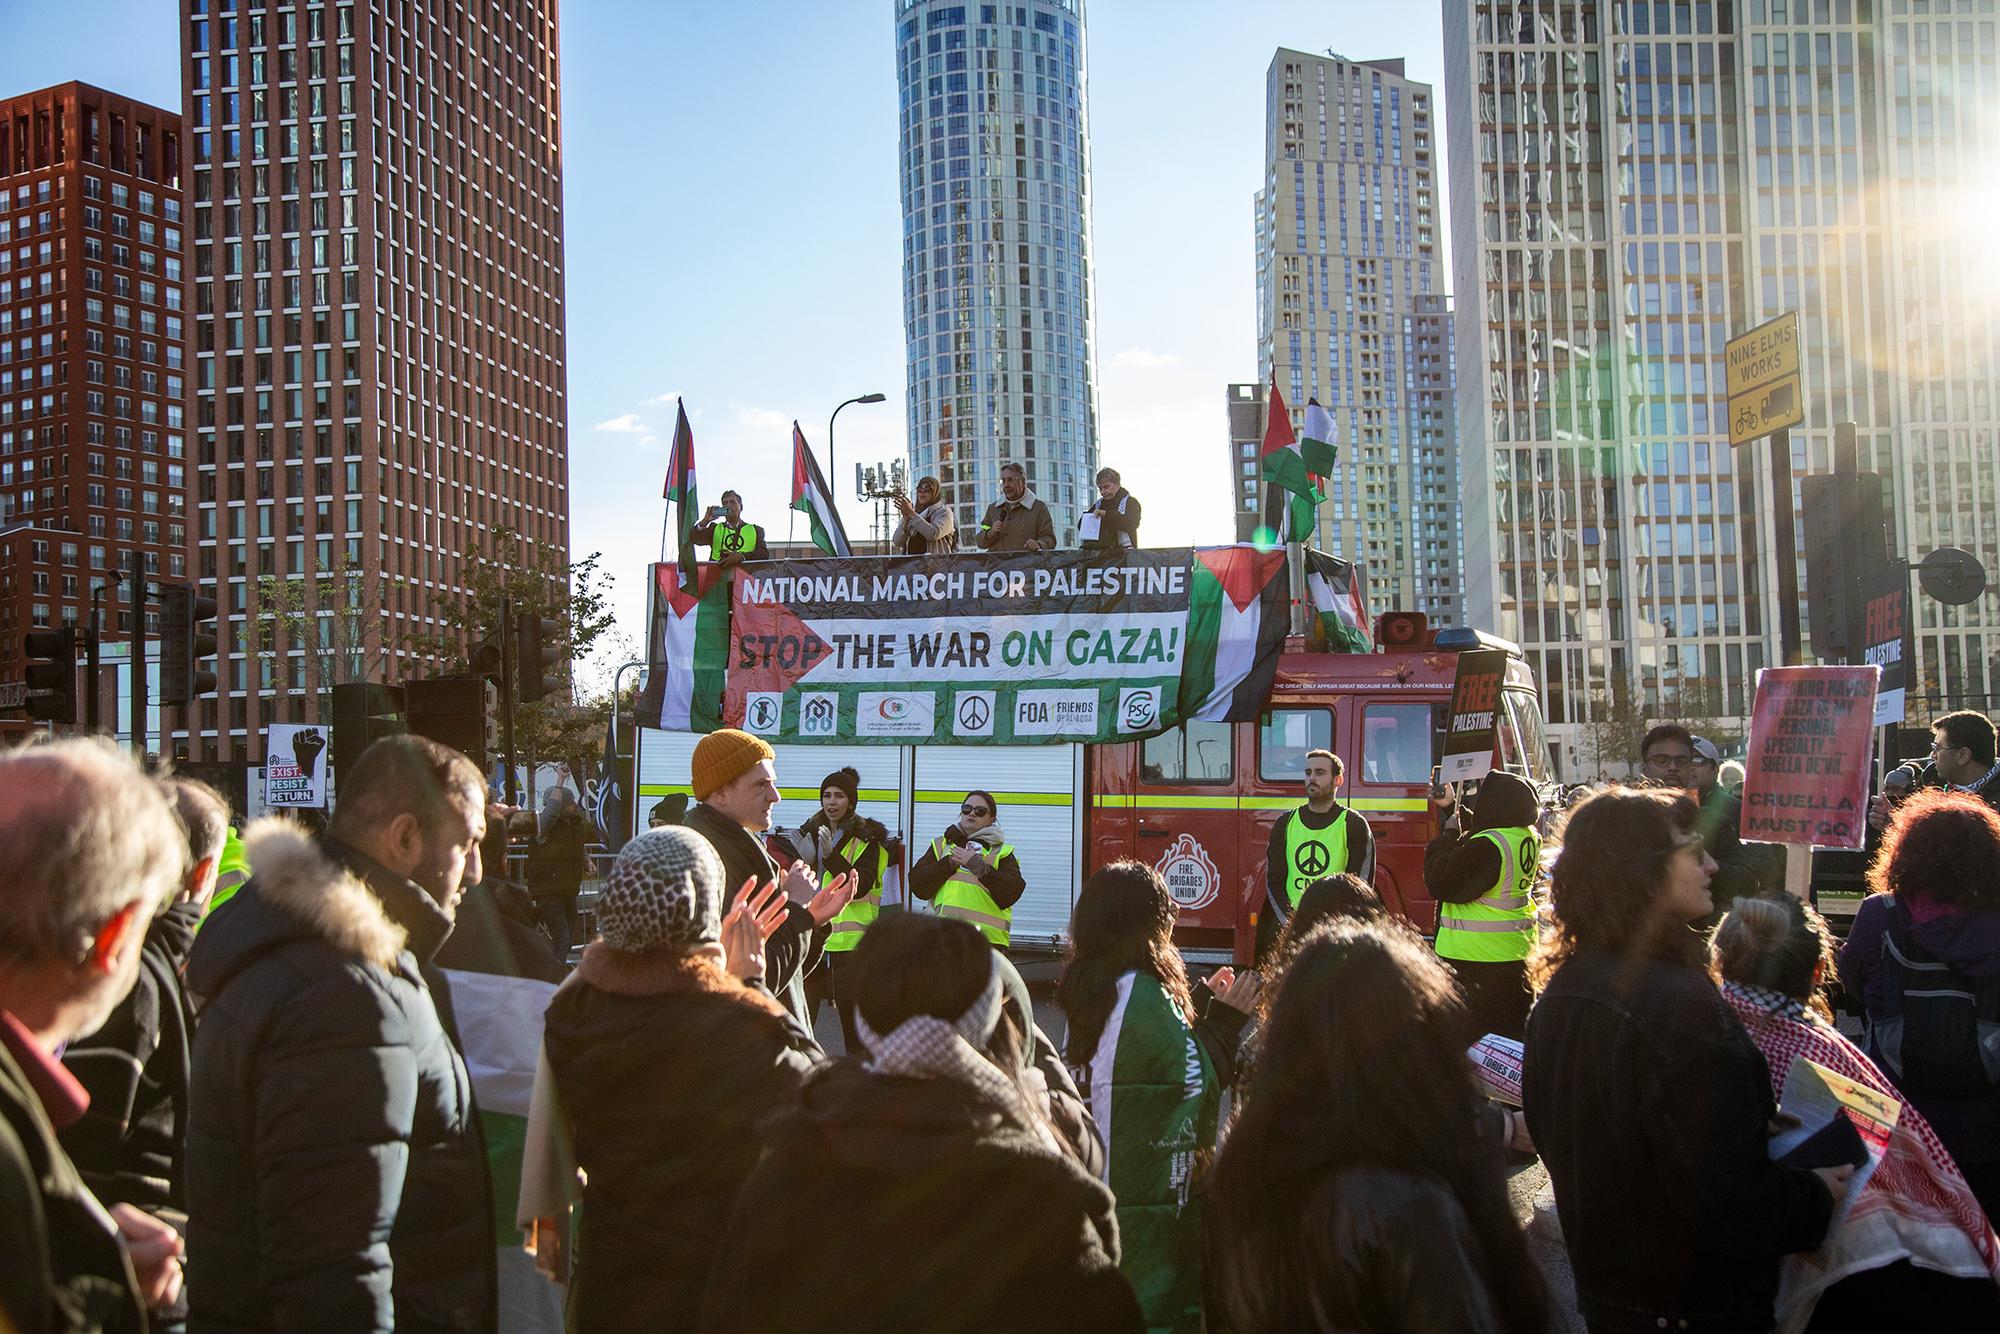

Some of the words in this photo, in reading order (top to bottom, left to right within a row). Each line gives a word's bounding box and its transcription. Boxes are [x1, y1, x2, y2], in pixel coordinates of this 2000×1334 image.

[1730, 341, 1757, 367] NINE
[1760, 325, 1791, 353] ELMS
[1740, 352, 1782, 383] WORKS
[742, 575, 865, 604] NATIONAL
[872, 572, 965, 601] MARCH
[972, 570, 1026, 599] FOR
[1034, 566, 1186, 598] PALESTINE
[1866, 590, 1902, 647] FREE
[738, 634, 823, 669] STOP
[832, 634, 897, 669] THE
[907, 631, 991, 668] WAR
[1001, 629, 1053, 667] ON
[1066, 627, 1179, 667] GAZA!
[1865, 638, 1902, 666] PALESTINE
[1455, 672, 1499, 713] FREE
[1019, 702, 1048, 723] FOA
[1056, 701, 1093, 713] FRIENDS
[1128, 703, 1151, 718] PSC
[1784, 699, 1813, 716] GAZA
[1832, 699, 1855, 717] MY
[1452, 711, 1494, 733] PALESTINE
[1777, 718, 1837, 737] PERSONAL
[271, 767, 302, 777] EXIST.
[1761, 755, 1801, 774] SUELLA
[271, 780, 307, 789] RESIST.
[271, 791, 314, 802] RETURN.
[1748, 792, 1855, 812] CRUELLA
[1748, 817, 1812, 833] MUST
[1815, 821, 1850, 837] GO
[1178, 864, 1194, 875] FIRE
[1170, 875, 1203, 887] BRIGADES
[1175, 887, 1197, 898] UNION
[1483, 1056, 1508, 1075] TORIES
